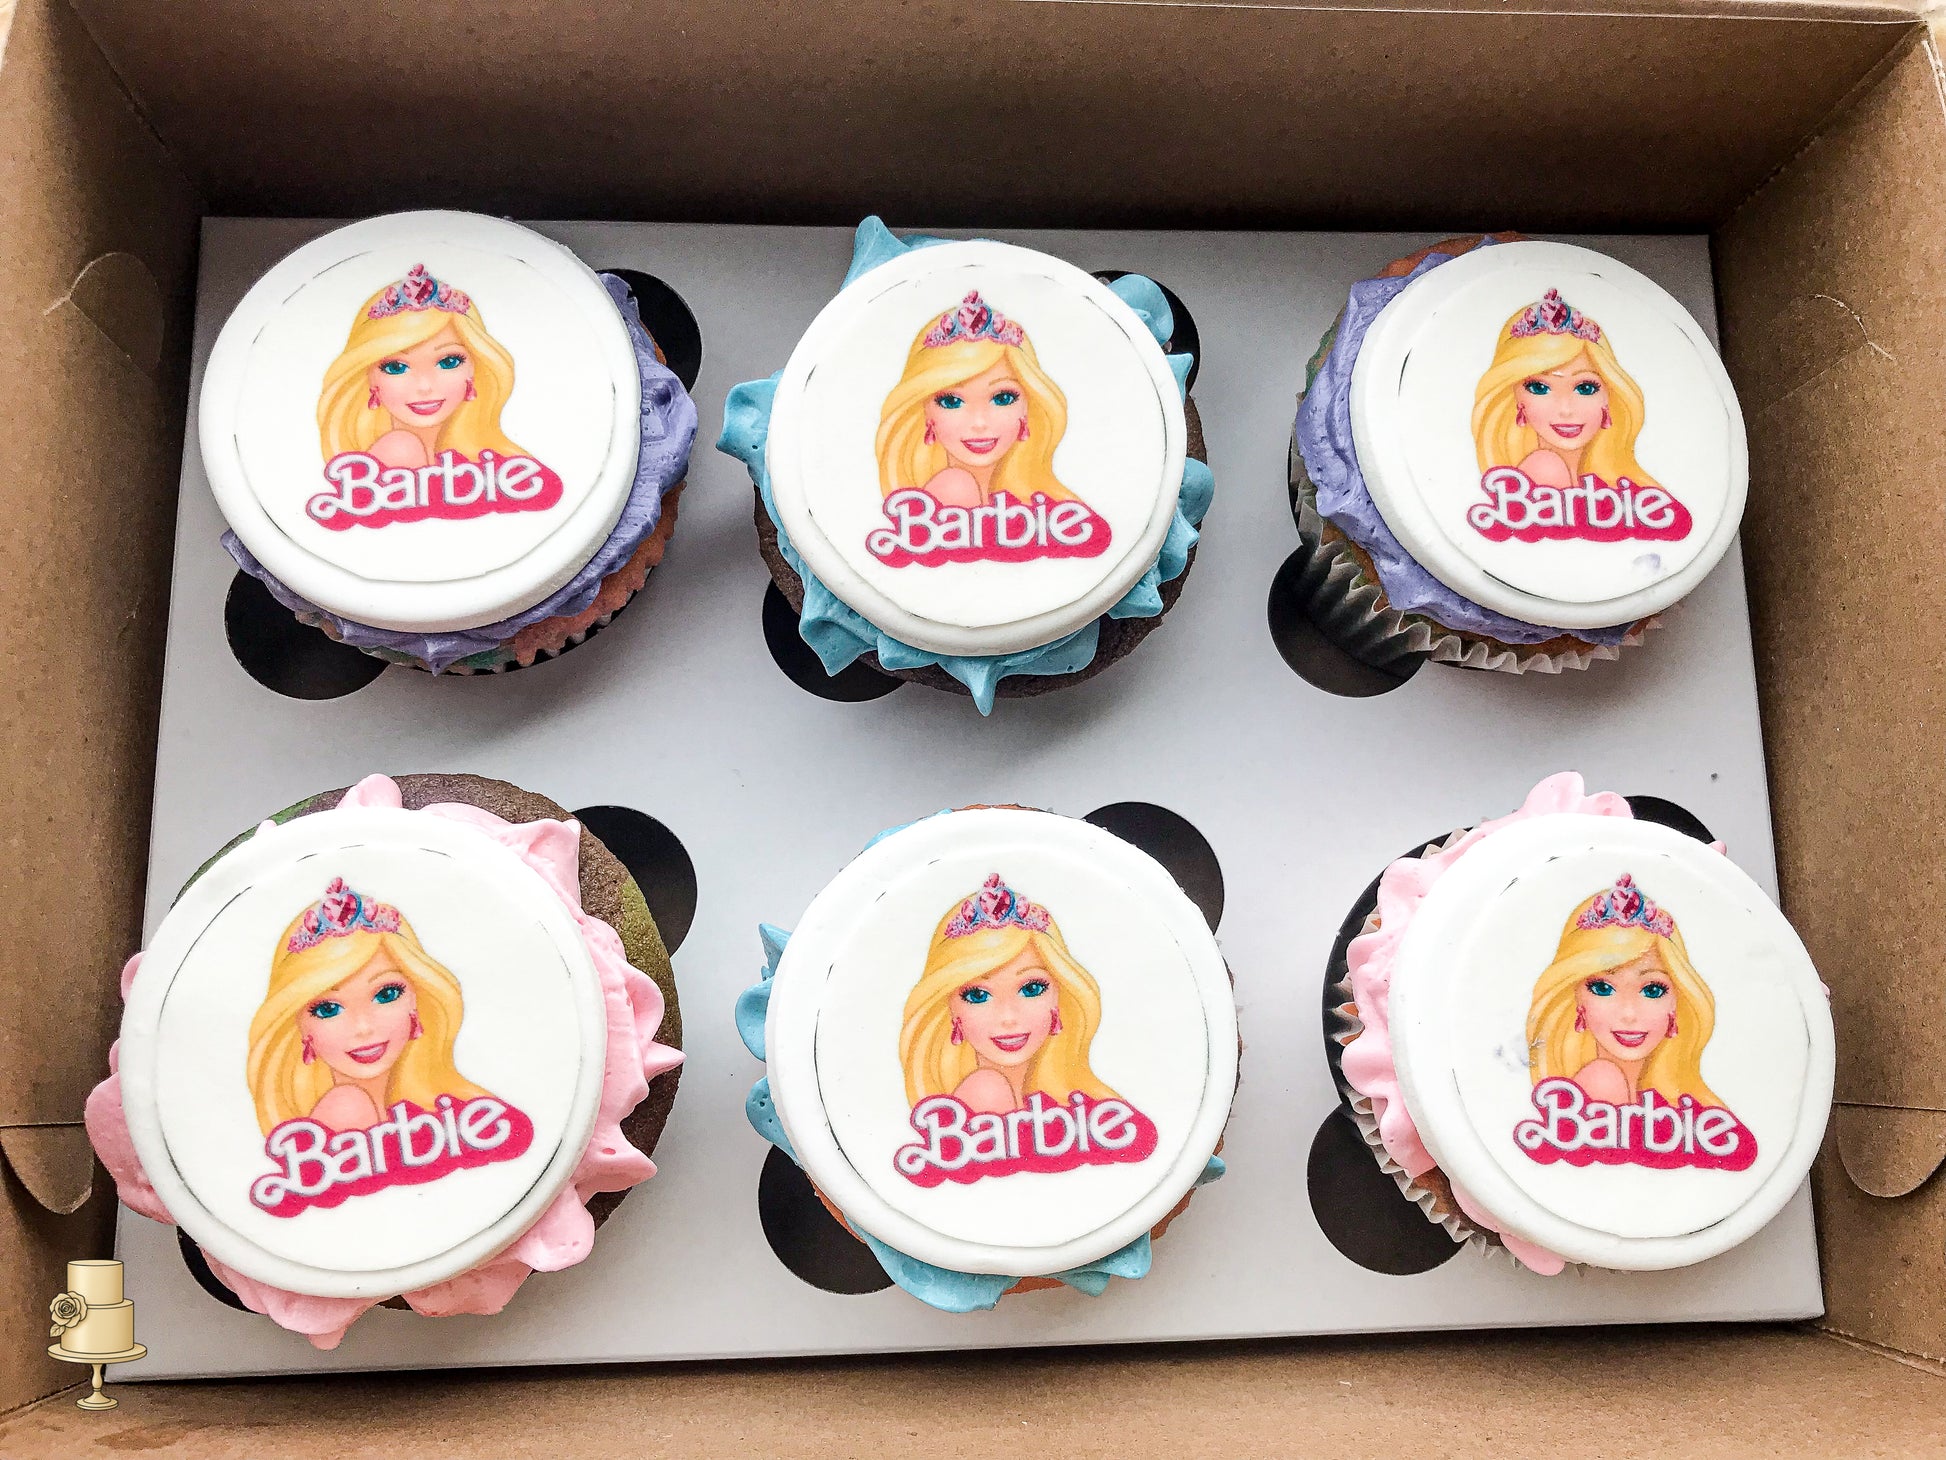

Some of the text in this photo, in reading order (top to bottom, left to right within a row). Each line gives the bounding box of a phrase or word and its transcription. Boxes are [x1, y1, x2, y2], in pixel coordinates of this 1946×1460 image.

[308, 450, 545, 519] Barbie
[1468, 467, 1676, 530] Barbie
[868, 489, 1094, 556] Barbie
[254, 1096, 512, 1206] Barbie
[895, 1092, 1138, 1175] Barbie
[1516, 1080, 1740, 1156] Barbie
